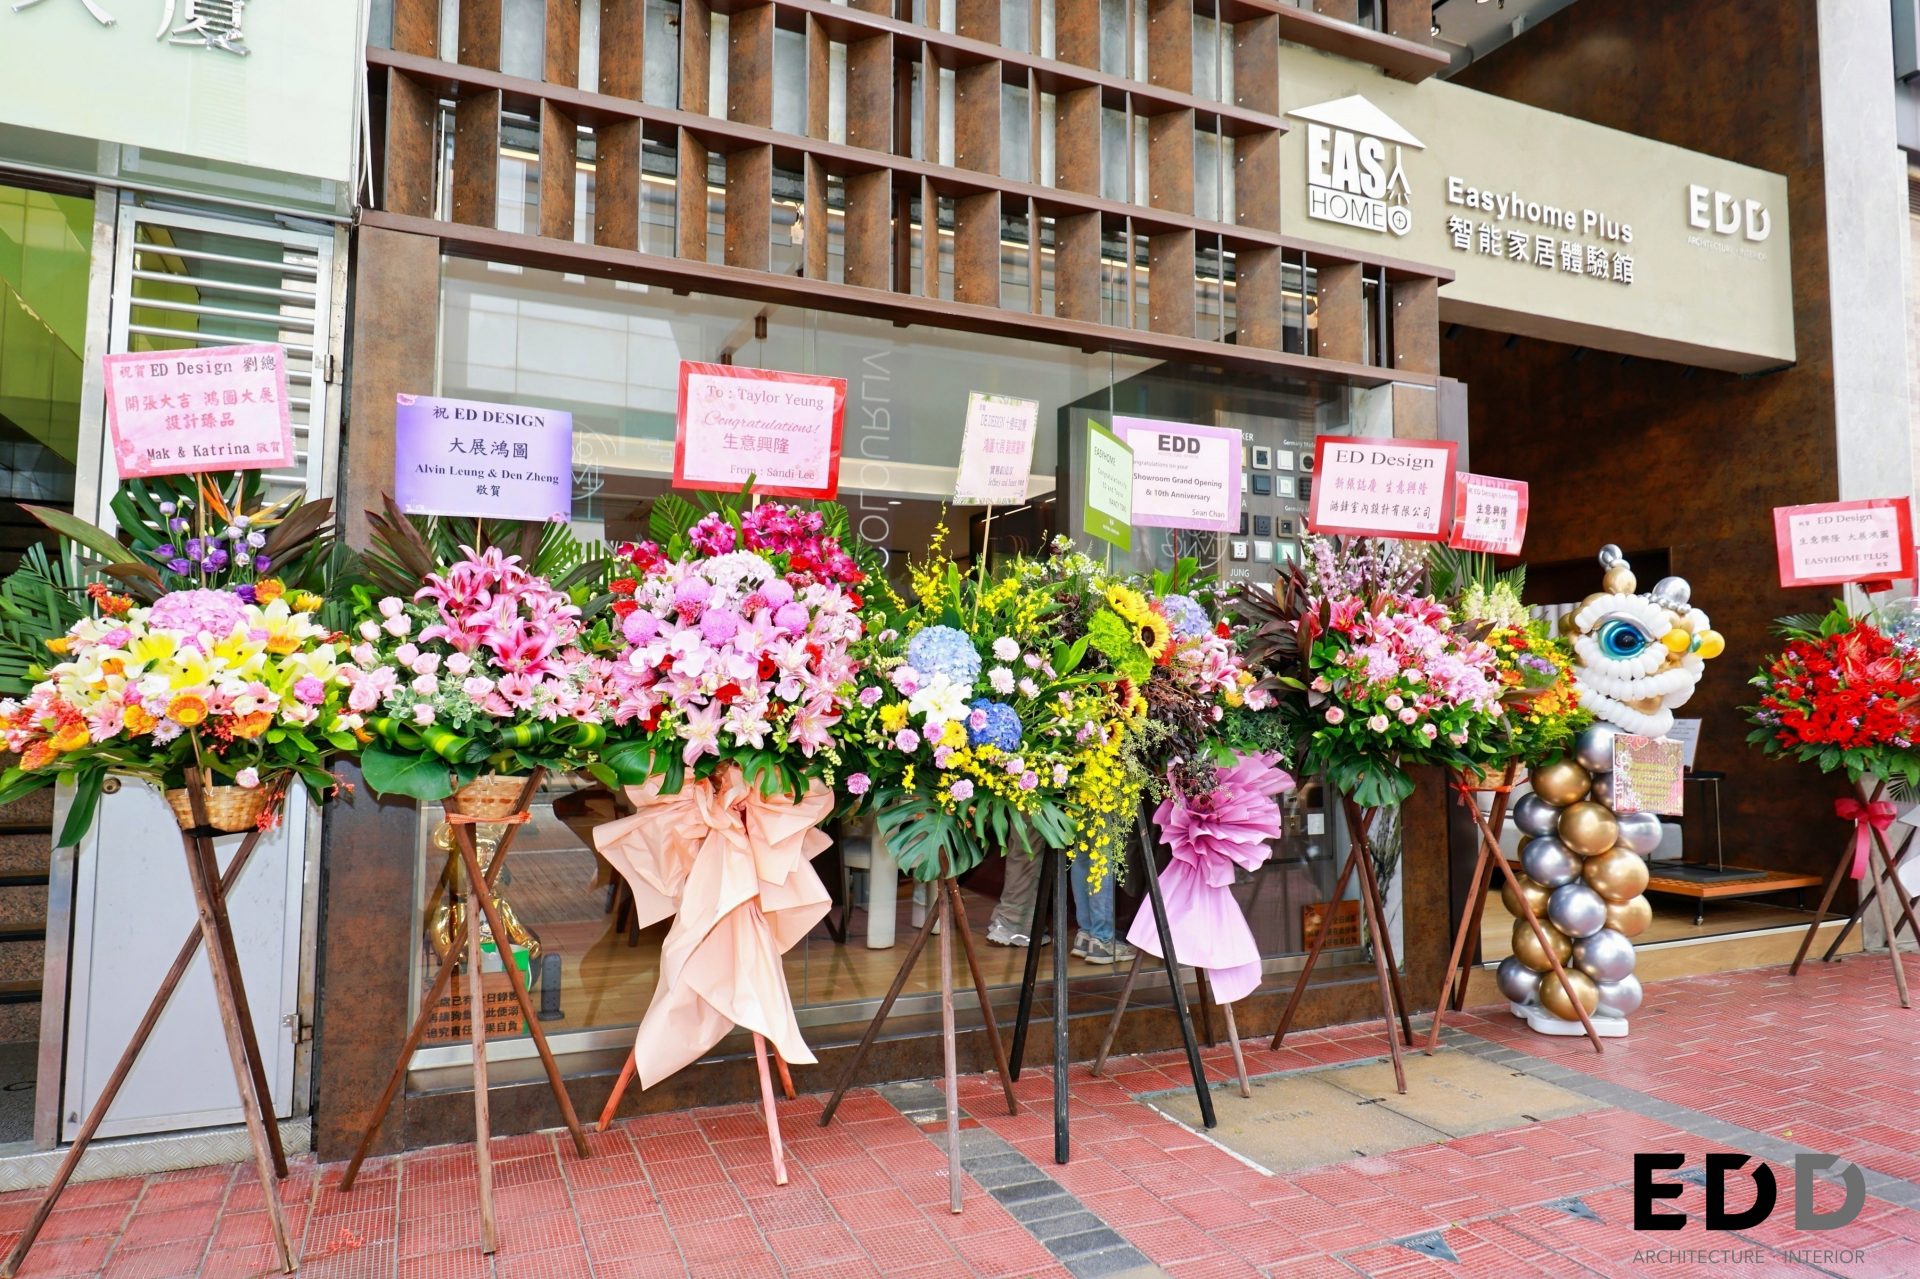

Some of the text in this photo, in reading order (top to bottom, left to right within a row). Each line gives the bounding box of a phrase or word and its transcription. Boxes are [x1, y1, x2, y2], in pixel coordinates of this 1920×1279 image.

[1312, 190, 1384, 229] HOME
[1448, 176, 1633, 244] Easyhome Plus
[1690, 183, 1771, 242] EDD
[1448, 215, 1633, 284] 智能家居體驗館
[151, 364, 169, 377] ED
[177, 361, 233, 376] Design
[125, 387, 275, 413] 開張大吉 鴻圖大展
[738, 387, 780, 405] Taylor
[785, 393, 824, 411] Yeung
[433, 406, 546, 427] 祝 ED DESIGN
[704, 410, 821, 434] Congratulations!
[147, 447, 170, 461] Mak
[178, 446, 186, 457] &
[193, 443, 250, 457] Katrina
[448, 437, 529, 460] 大展鴻圖
[723, 433, 790, 455] 生意興隆
[1158, 434, 1200, 454] EDD
[1133, 459, 1169, 469] ongratulations
[1336, 449, 1434, 471] ED Design
[415, 464, 560, 485] Alvin Leung & Den Zheng
[766, 467, 795, 478] Sandi
[798, 470, 815, 480] Lee
[1133, 473, 1223, 489] Showroom Grand Opening
[476, 485, 501, 497] 敬賀
[1146, 488, 1211, 503] & 10th Anniversary
[1386, 479, 1429, 496] 生意興隆
[1192, 508, 1225, 519] Sean Chan
[1817, 516, 1833, 525] ED
[1836, 513, 1873, 523] Design
[1799, 534, 1841, 546] 生意興隆
[1805, 552, 1889, 566] EASYHOME PLUS
[1230, 567, 1250, 578] JUNG
